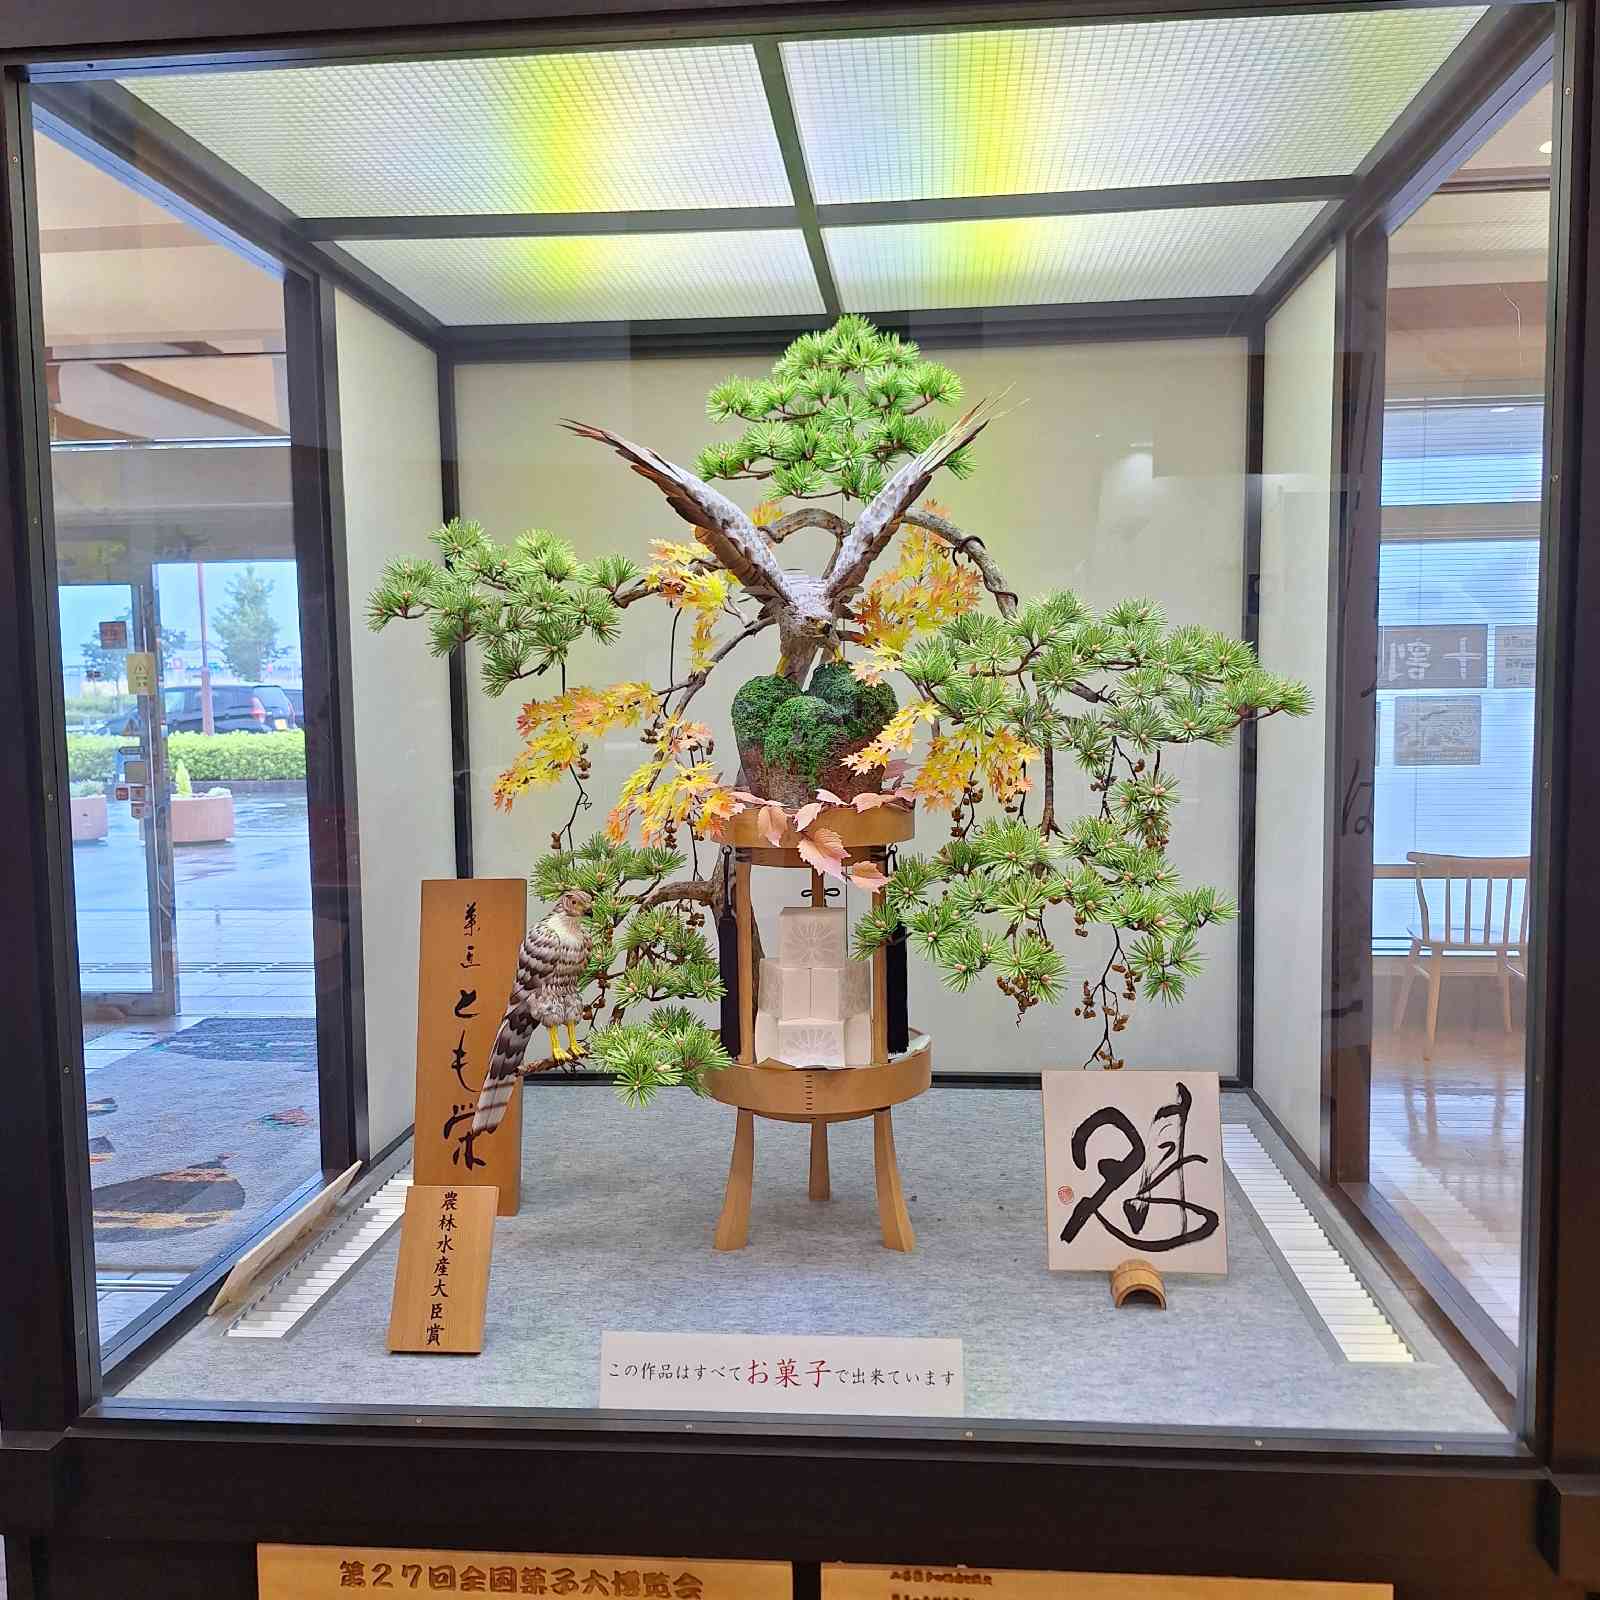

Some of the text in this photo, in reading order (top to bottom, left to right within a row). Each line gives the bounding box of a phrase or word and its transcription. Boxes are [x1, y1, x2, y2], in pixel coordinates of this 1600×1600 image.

[425, 1190, 458, 1346] 農林水産大臣賞
[606, 1358, 956, 1388] この作品はすべてお菓子で出来ています
